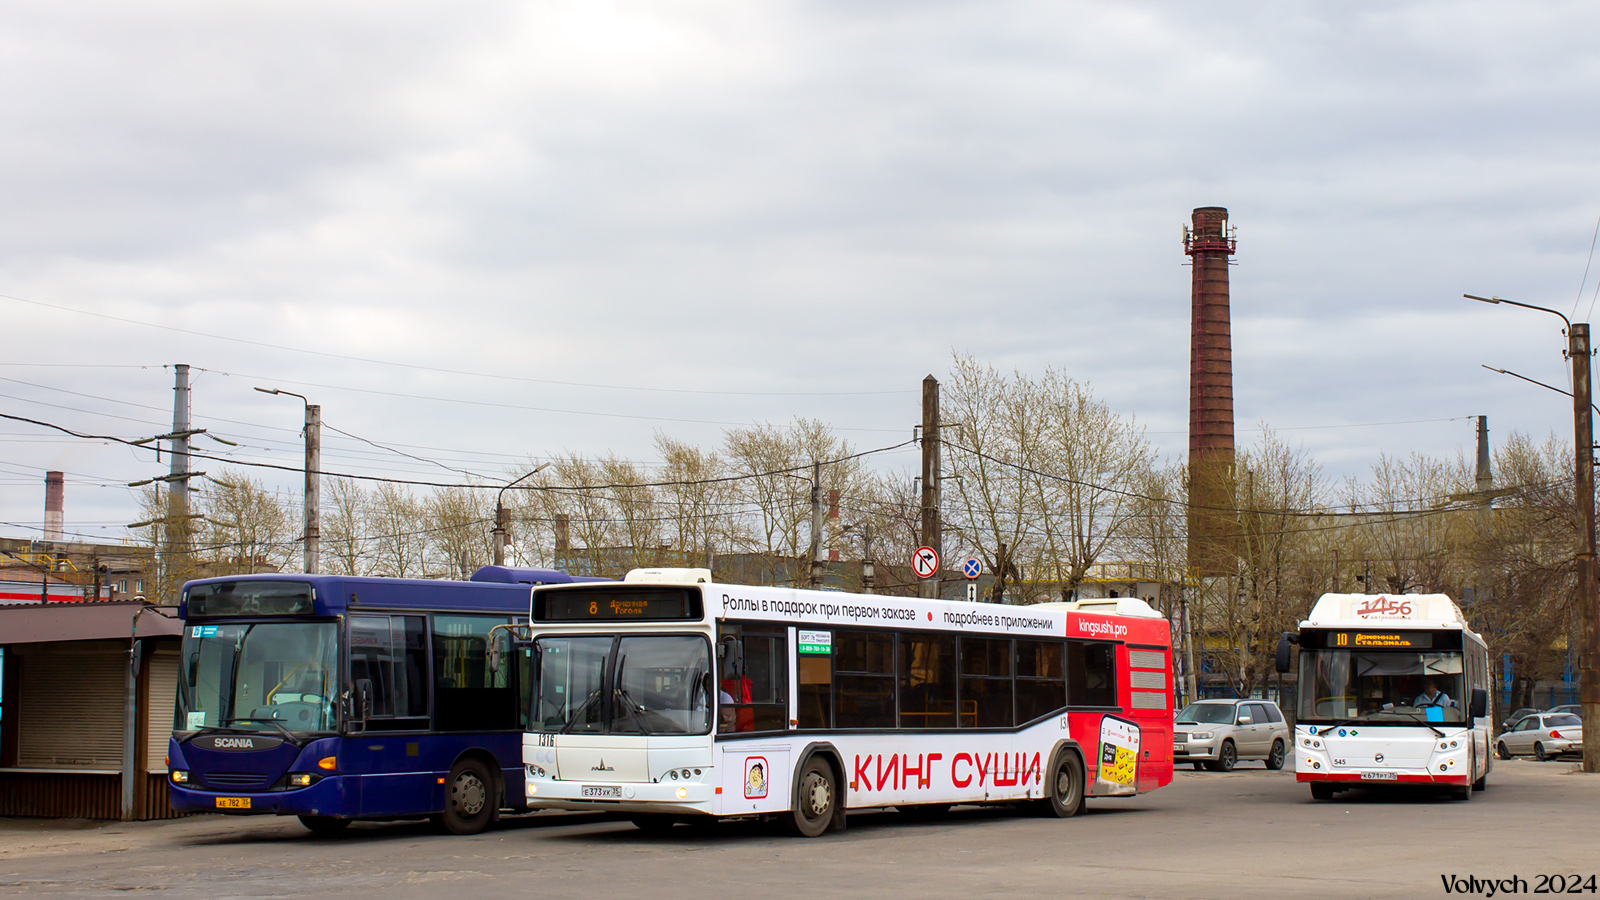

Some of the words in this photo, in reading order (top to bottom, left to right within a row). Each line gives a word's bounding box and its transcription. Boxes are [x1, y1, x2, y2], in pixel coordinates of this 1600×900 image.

[589, 601, 598, 615] 8
[615, 607, 642, 615] Гоголя
[722, 594, 759, 611] Роллы
[762, 601, 768, 612] в
[771, 600, 817, 618] подарок
[820, 604, 840, 620] при
[842, 606, 879, 621] первом
[882, 607, 916, 621] заказе
[1357, 595, 1412, 615] 1456
[943, 610, 993, 629] подробнее
[995, 616, 1000, 626] в
[1001, 616, 1053, 631] приложении
[1078, 617, 1128, 638] kingsushi.pro
[1337, 633, 1348, 646] 10
[1355, 638, 1411, 646] Стальэмаль
[1356, 633, 1400, 641] Доменная
[1060, 716, 1073, 730] 1316
[214, 738, 253, 748] SCANIA
[538, 733, 555, 747] 1316
[854, 753, 942, 792] КИНГ
[951, 751, 1041, 789] СУШИ
[228, 798, 240, 807] 782
